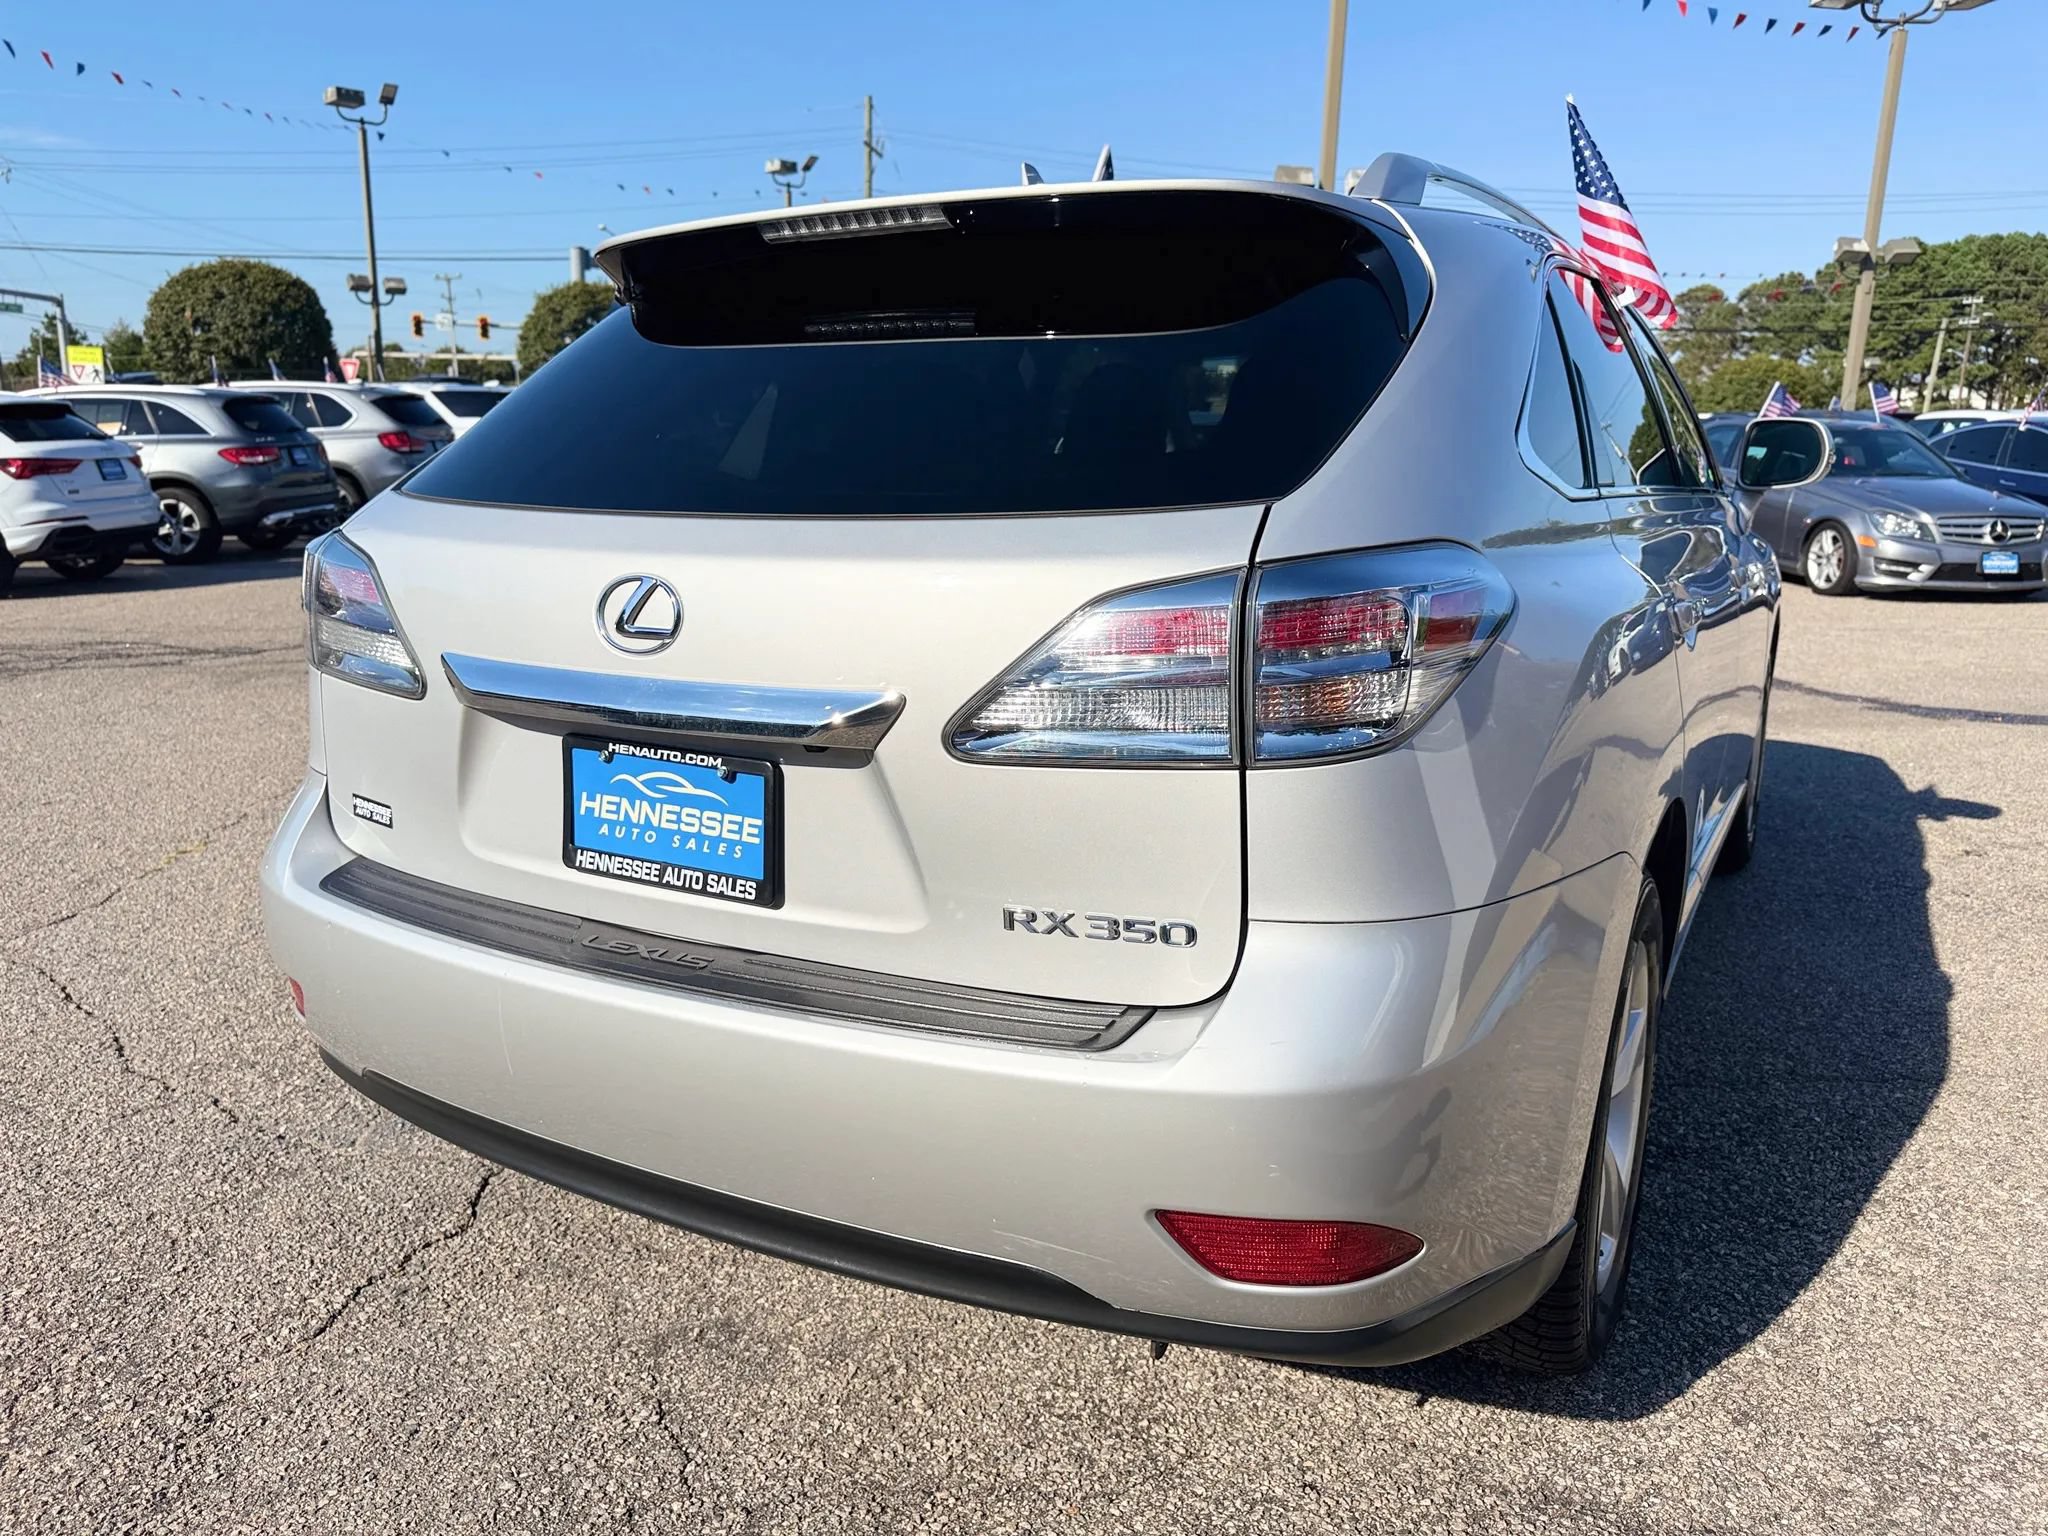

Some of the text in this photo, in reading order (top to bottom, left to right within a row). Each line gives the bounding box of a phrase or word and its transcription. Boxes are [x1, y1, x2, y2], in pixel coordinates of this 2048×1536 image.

[608, 742, 722, 768] HENAUTO.COM
[580, 791, 763, 844] HENNESSEE
[598, 823, 743, 859] AUTO SALES
[575, 849, 757, 900] HENNESSEE AUTO SALES
[1084, 911, 1198, 949] 350
[581, 935, 715, 970] LEXUS
